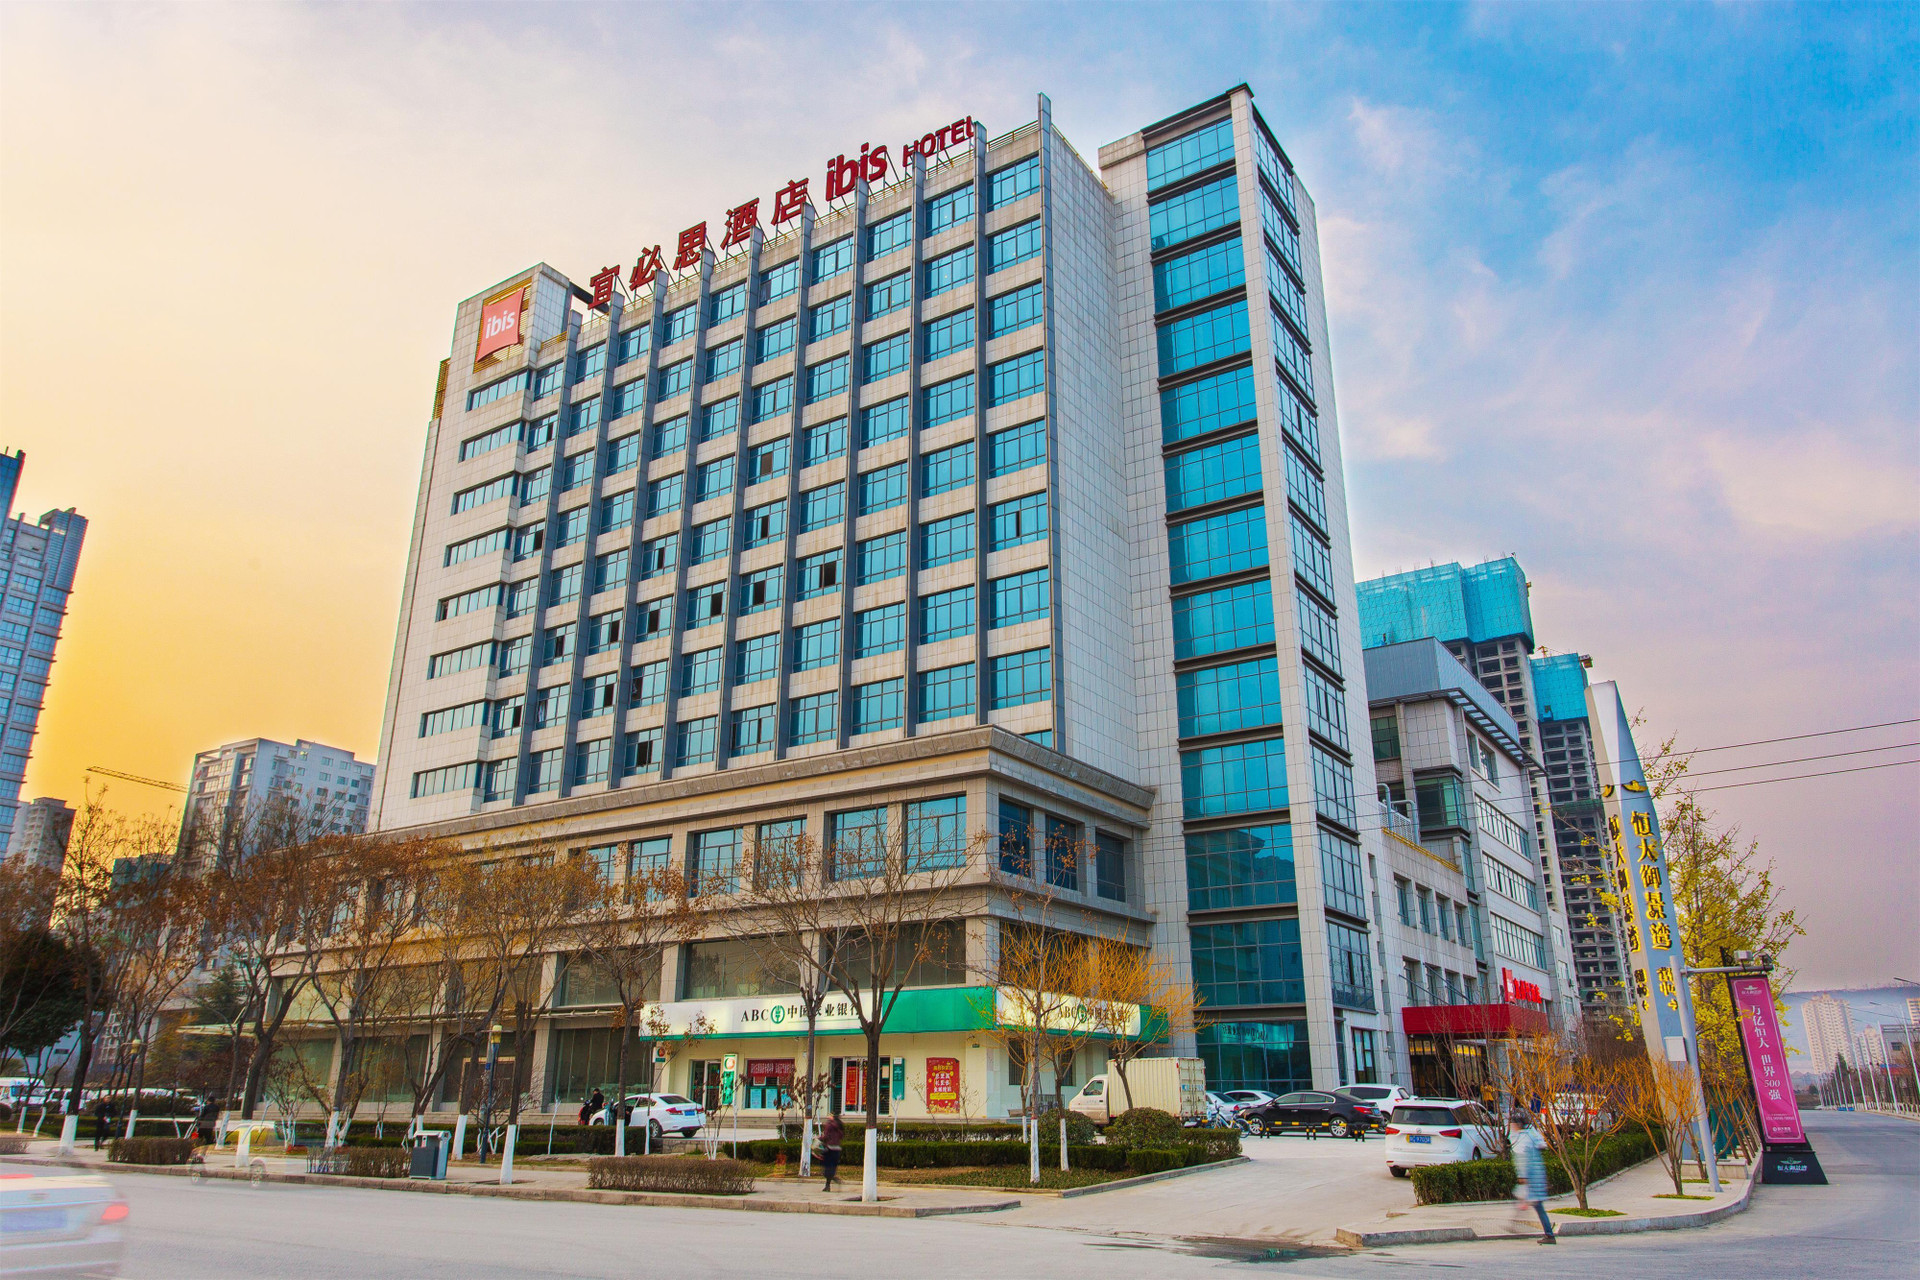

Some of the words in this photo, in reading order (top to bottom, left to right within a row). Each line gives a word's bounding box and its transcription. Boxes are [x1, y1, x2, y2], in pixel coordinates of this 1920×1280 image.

[588, 178, 809, 310] 宜必思酒店
[826, 142, 888, 201] ibis
[902, 115, 974, 167] HOTEL
[485, 310, 515, 339] ibis
[741, 1009, 769, 1022] ABC
